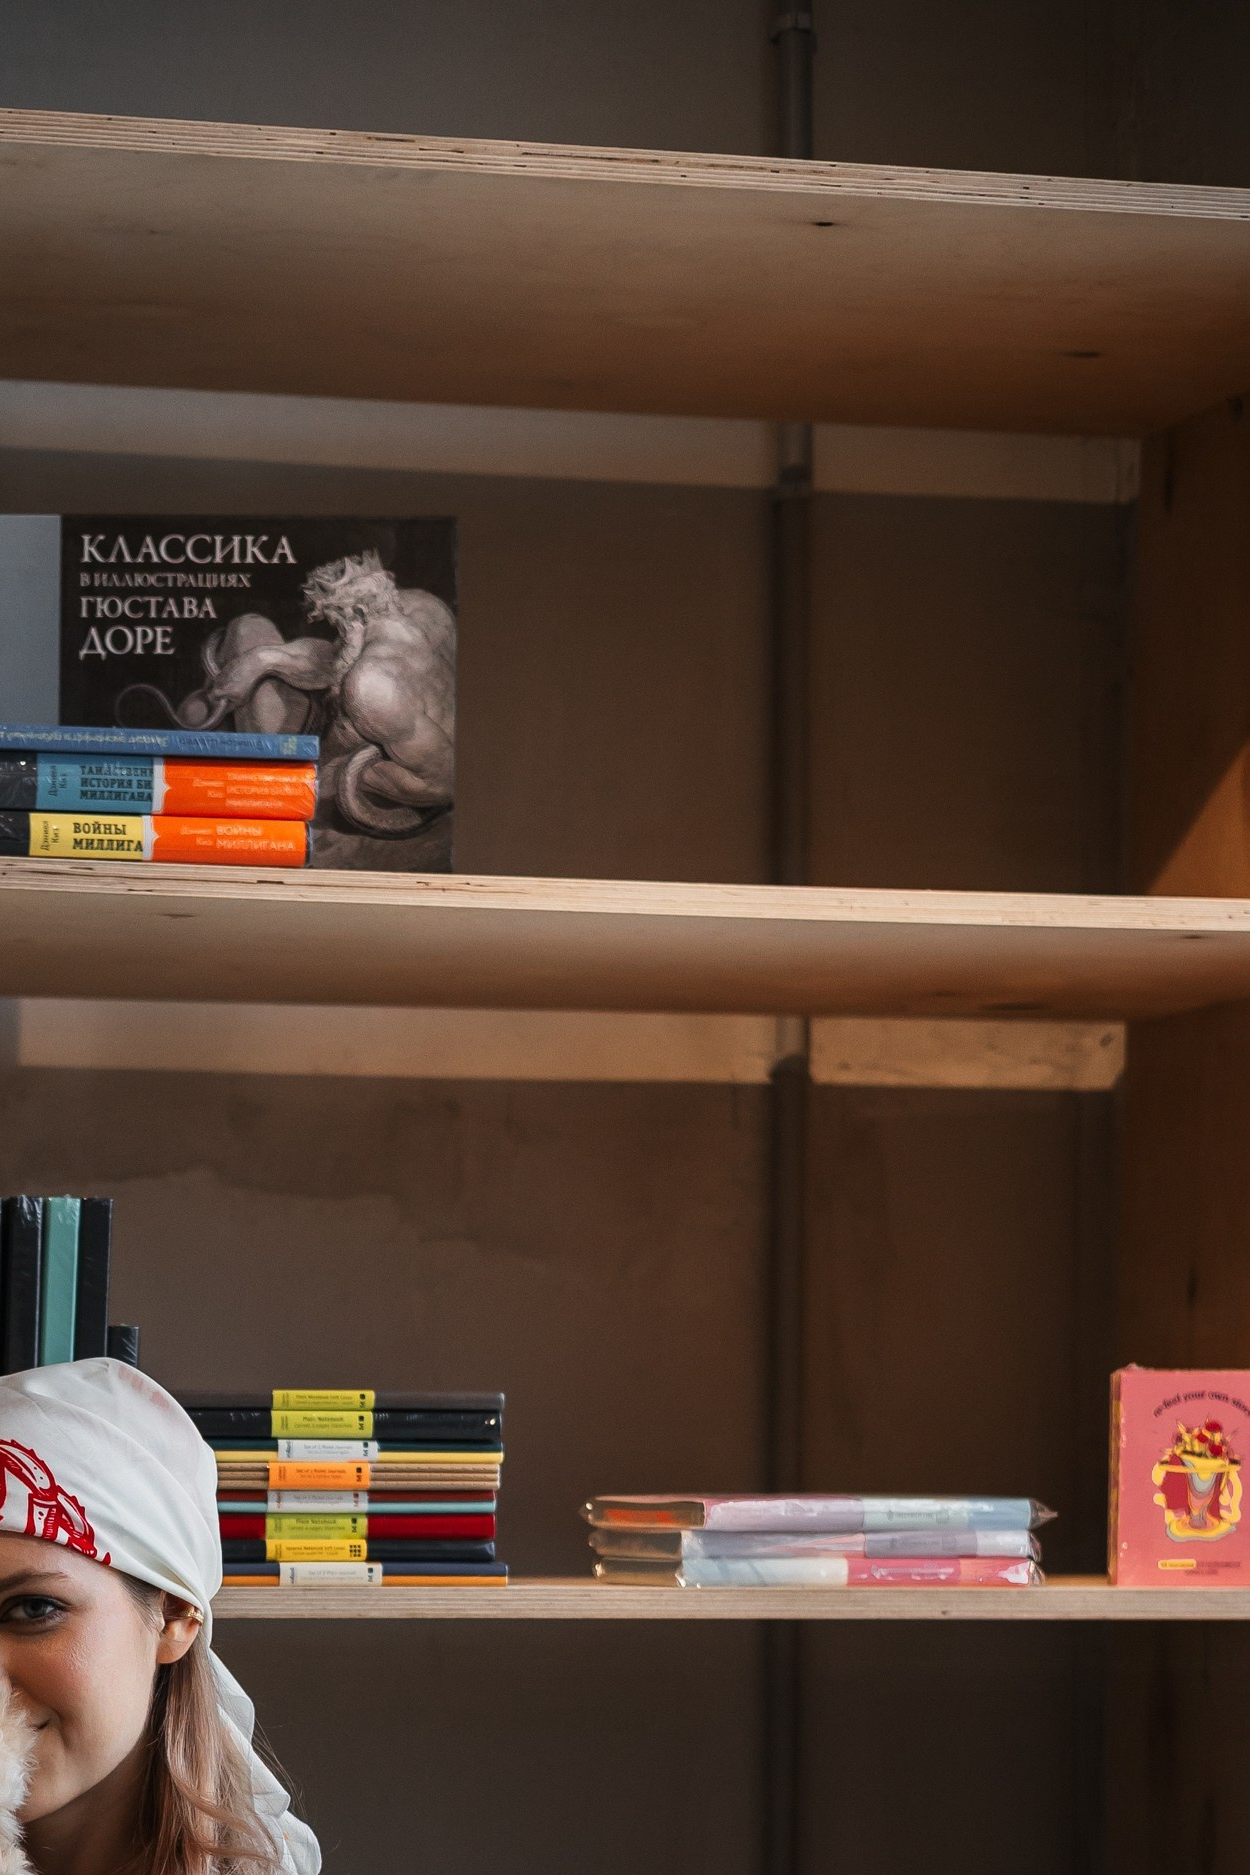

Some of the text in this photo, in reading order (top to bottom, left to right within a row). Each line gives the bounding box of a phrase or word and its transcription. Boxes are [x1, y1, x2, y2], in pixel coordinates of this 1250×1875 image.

[80, 533, 298, 565] КЛАССИКА
[80, 573, 252, 588] В ИЛЛЮСТРАЦИЯХ
[80, 597, 217, 619] ГЮСТАВА
[80, 625, 175, 659] ДОРЕ
[80, 779, 132, 788] ИСТОРИЯ
[73, 822, 126, 835] ВОЙНЫ
[216, 826, 263, 836] ВОЙНЫ
[73, 839, 143, 851] МИЛЛИГА
[216, 839, 295, 850] МИЛЛИГАНА
